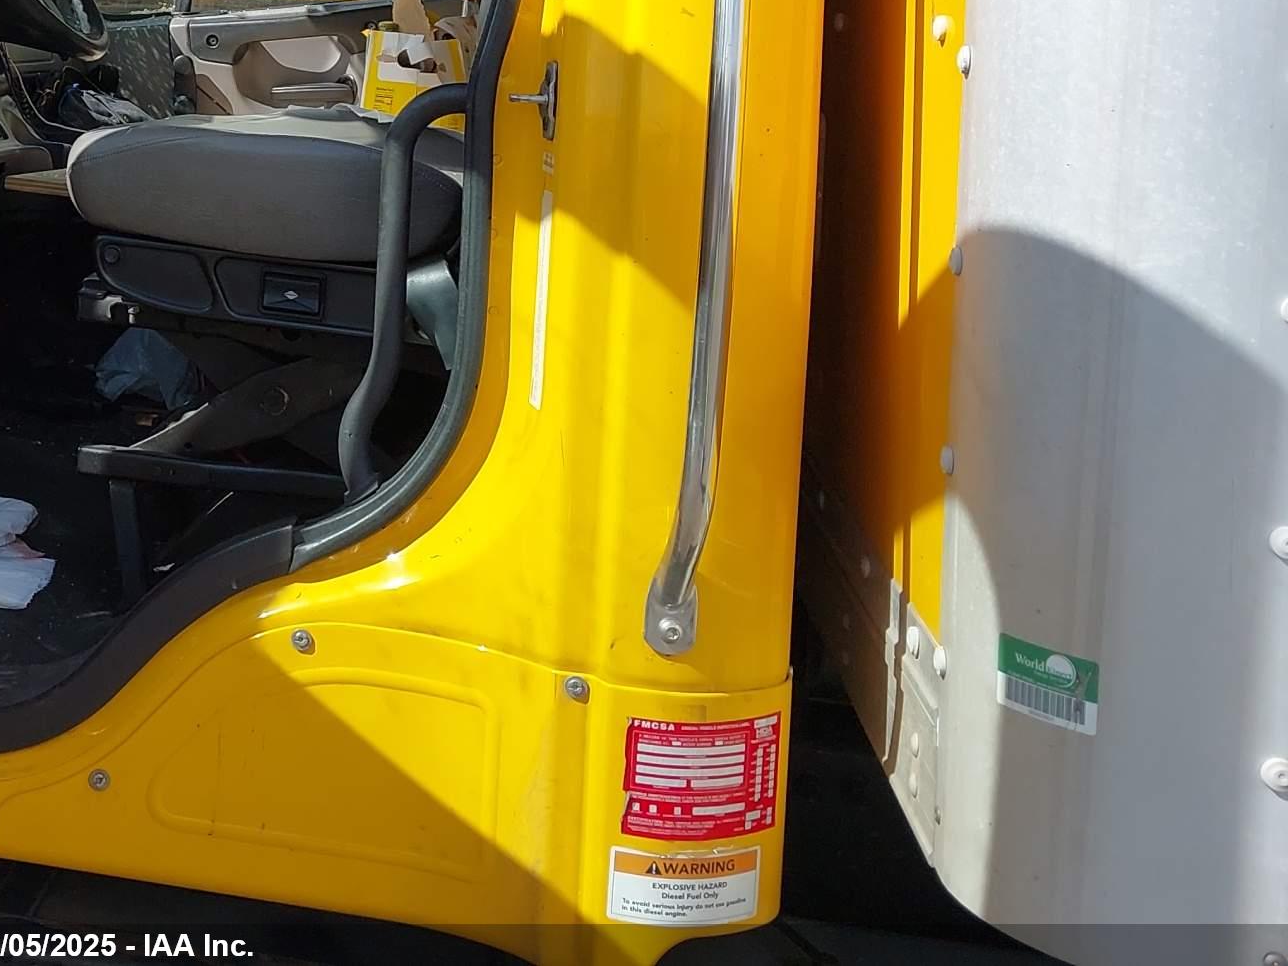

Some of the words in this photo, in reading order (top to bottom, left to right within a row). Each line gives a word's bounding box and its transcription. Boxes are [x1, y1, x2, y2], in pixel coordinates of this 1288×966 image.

[1015, 651, 1046, 671] World
[634, 719, 675, 731] FMCSA
[663, 860, 735, 874] WARNING
[652, 882, 696, 890] EXPLOSIVE
[698, 882, 727, 890] HAZARD
